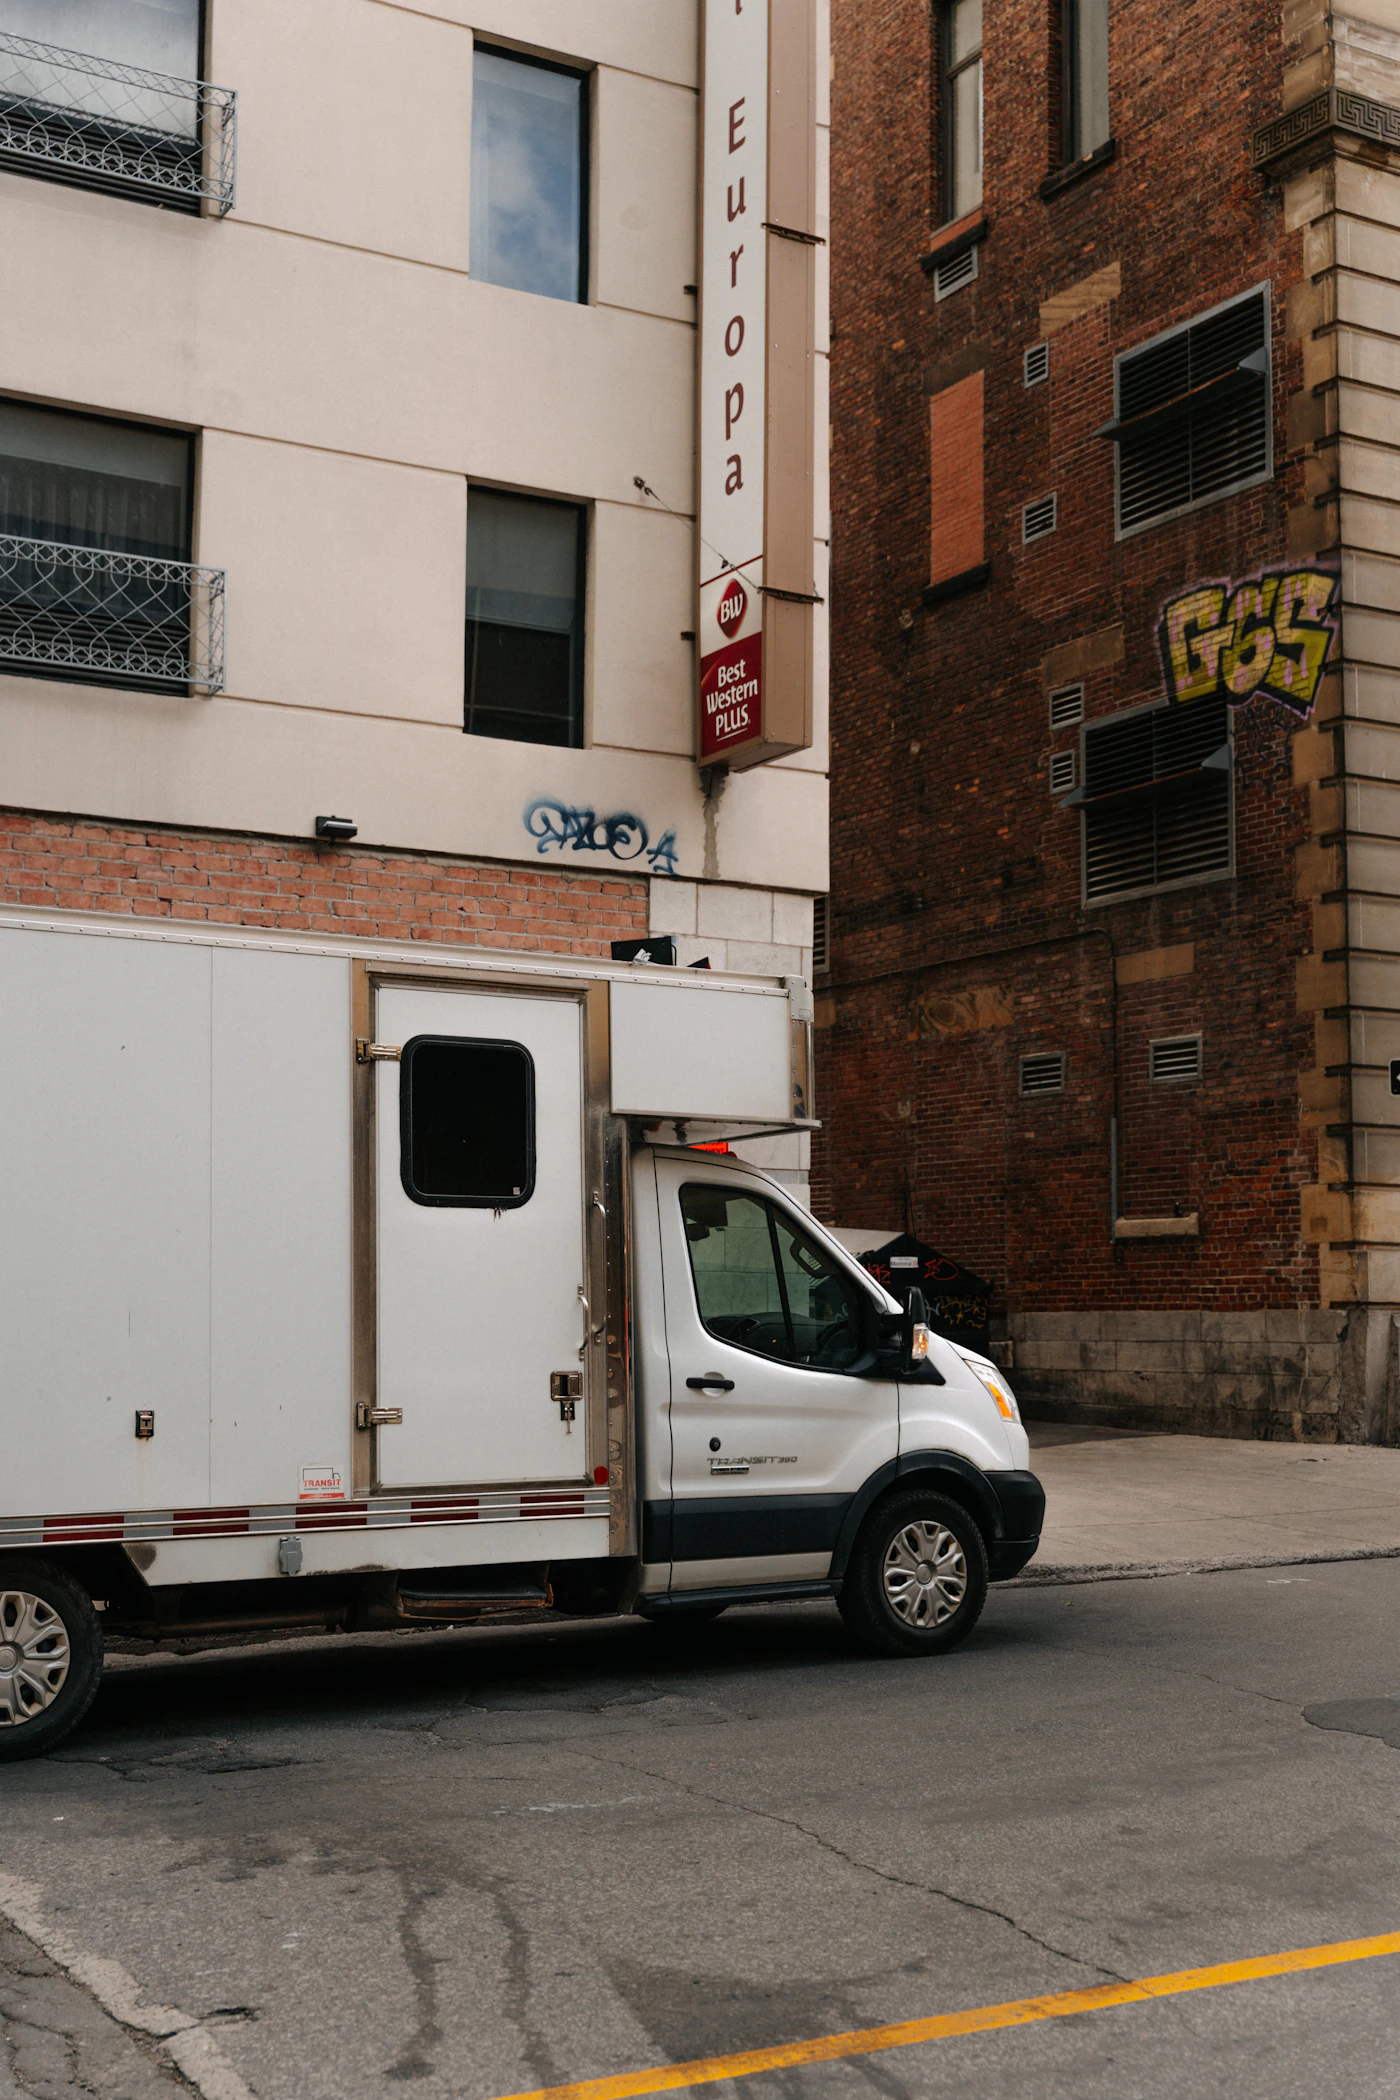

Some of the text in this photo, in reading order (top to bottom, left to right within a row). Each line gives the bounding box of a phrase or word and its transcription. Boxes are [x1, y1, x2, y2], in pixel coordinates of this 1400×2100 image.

[725, 97, 747, 496] Europa
[720, 592, 744, 625] BW
[717, 659, 746, 688] Best
[706, 679, 758, 715] Western
[715, 704, 749, 737] PLUS
[303, 1479, 341, 1487] TRANSIT
